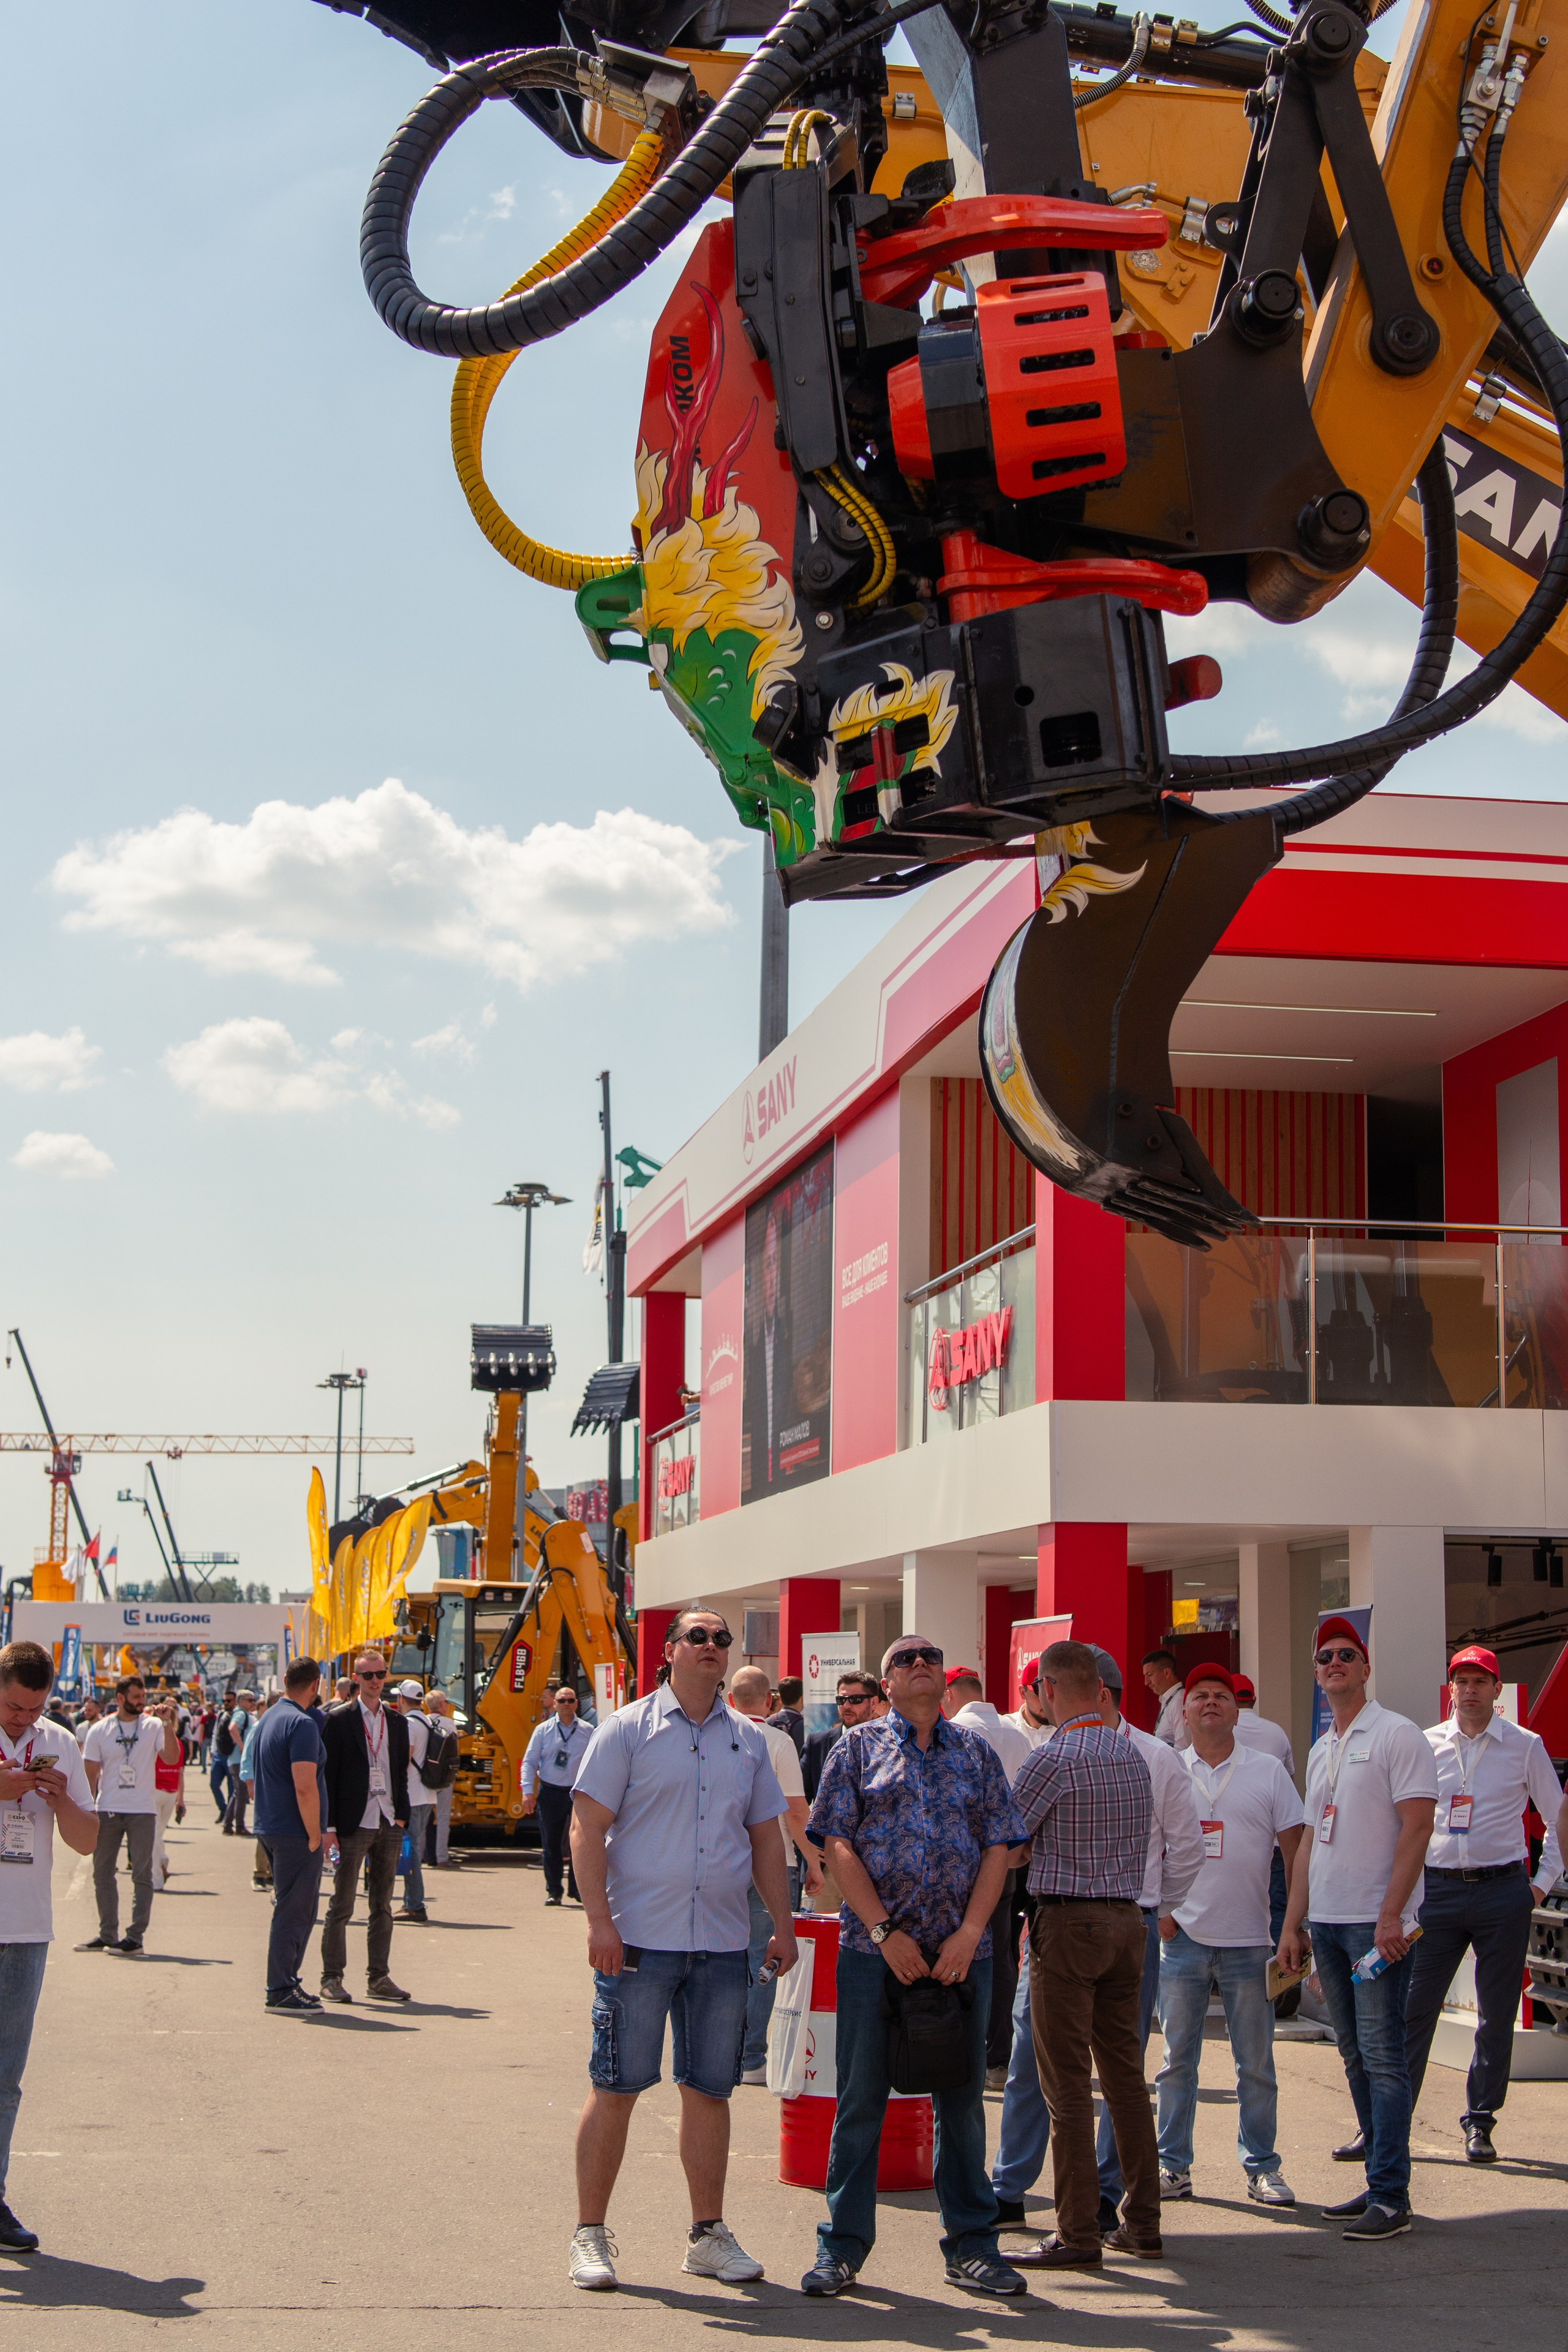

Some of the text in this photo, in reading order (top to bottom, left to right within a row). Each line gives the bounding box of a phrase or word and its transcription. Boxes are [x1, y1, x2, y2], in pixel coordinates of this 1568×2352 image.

[758, 1055, 797, 1140] SANY
[842, 1241, 888, 1289] ВСЕ ДЛЯ КЛИЕНТОВ
[951, 1305, 1009, 1387] SANY
[667, 1454, 693, 1498] SANY
